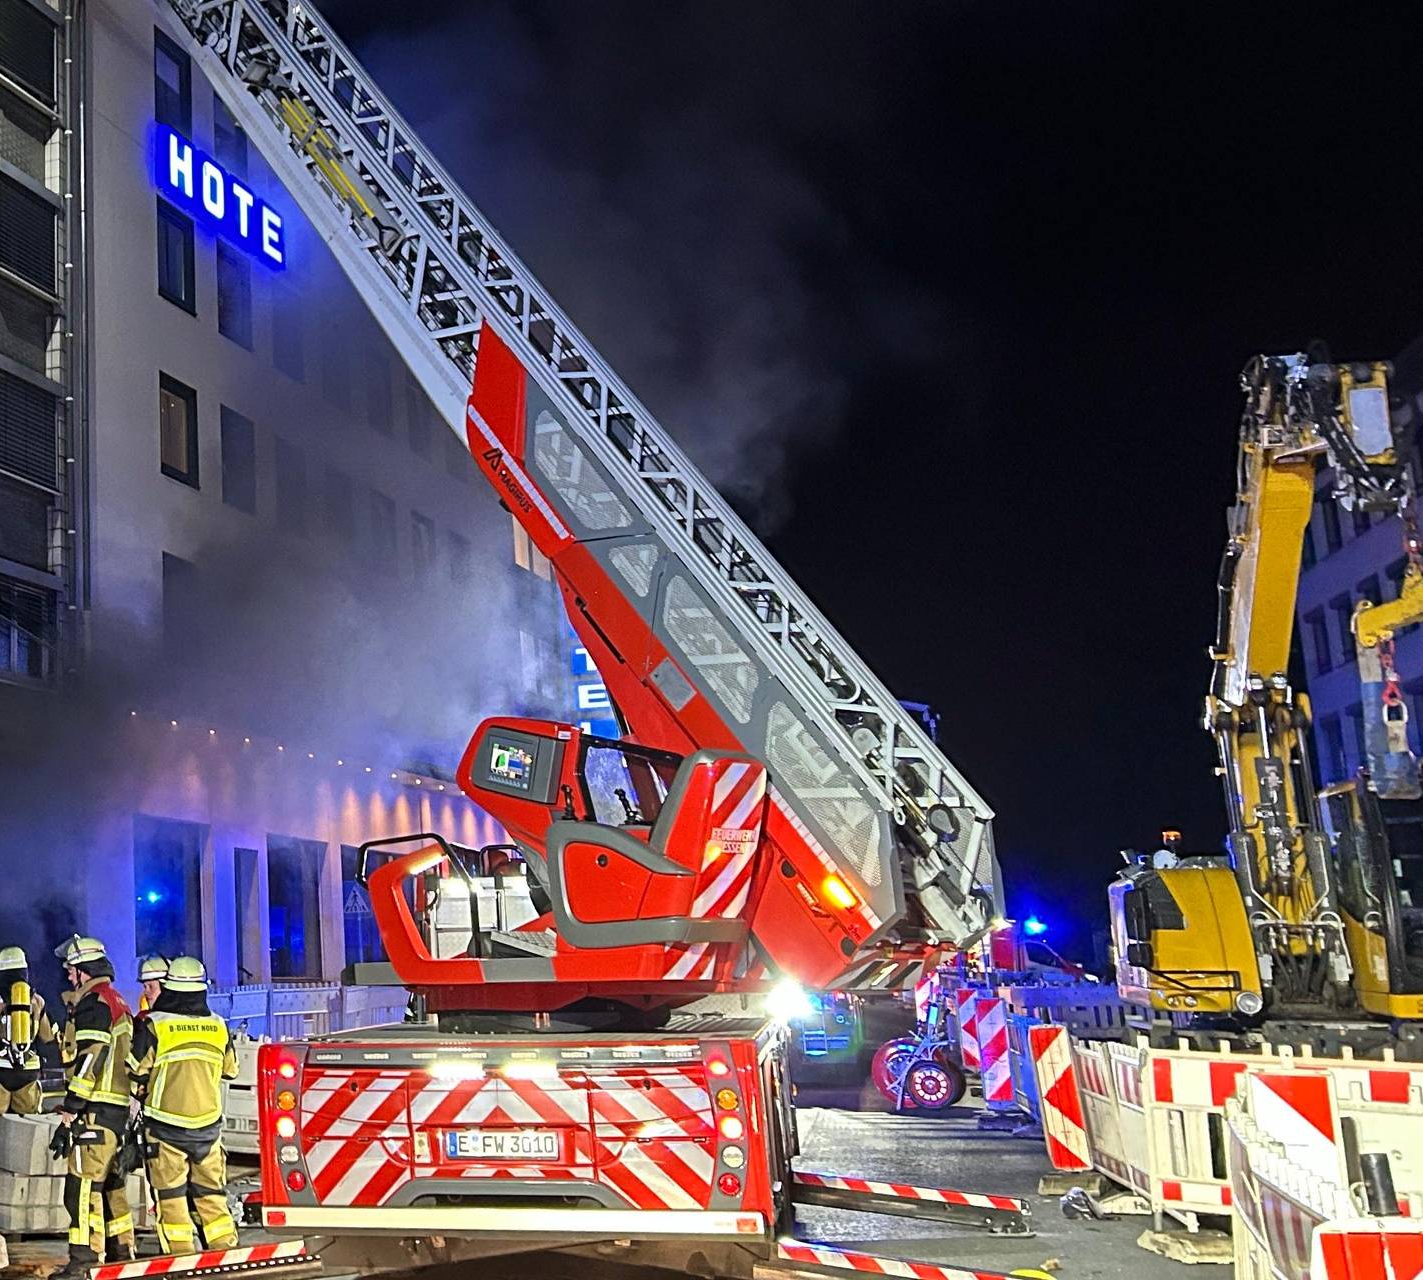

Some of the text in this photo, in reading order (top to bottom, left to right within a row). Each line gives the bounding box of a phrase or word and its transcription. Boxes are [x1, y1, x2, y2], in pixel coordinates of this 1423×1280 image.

[169, 133, 283, 263] HOTE
[499, 467, 533, 513] MAGIRUS
[201, 1024, 219, 1033] NORD
[458, 1135, 555, 1154] E FW 3010
